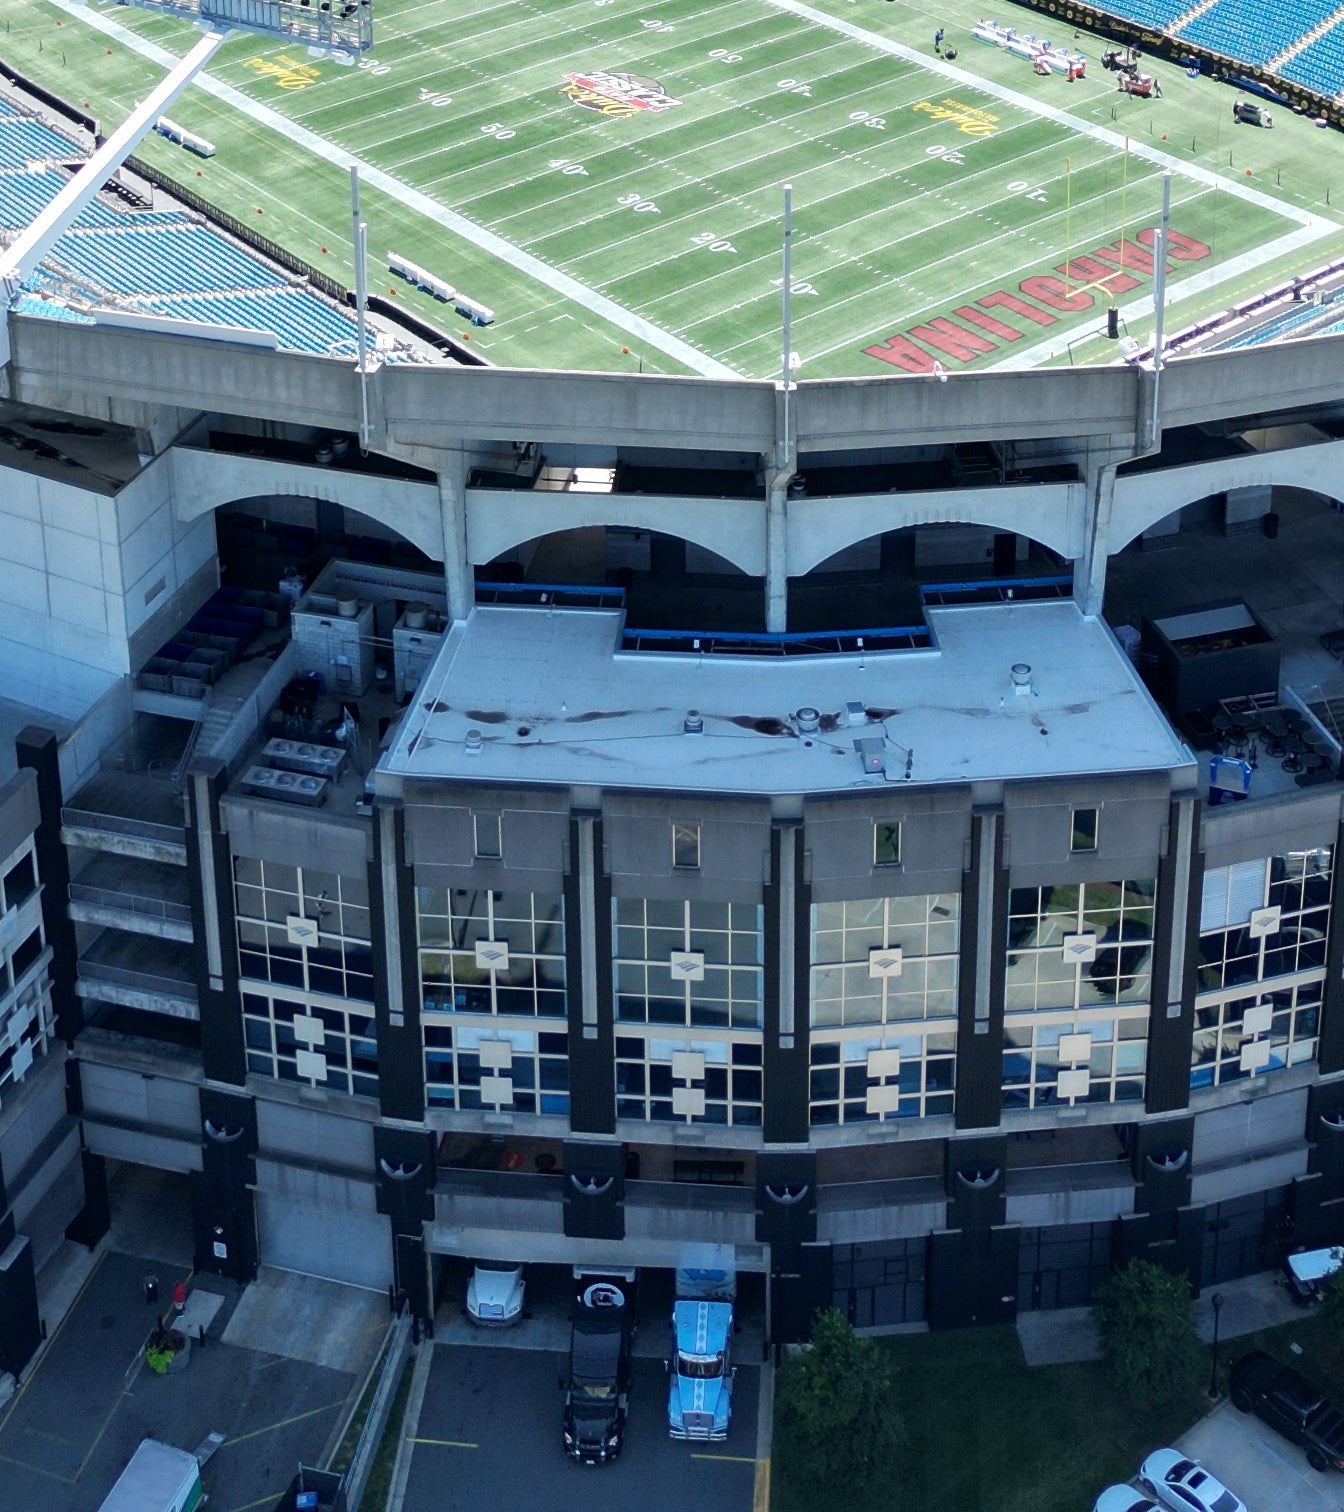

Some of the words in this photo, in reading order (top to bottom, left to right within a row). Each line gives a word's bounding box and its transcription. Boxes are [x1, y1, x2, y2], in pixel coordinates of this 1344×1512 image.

[643, 19, 677, 33] 40
[708, 48, 744, 64] 50
[357, 57, 392, 75] 30
[776, 79, 811, 96] 40
[419, 88, 452, 107] 40
[848, 111, 886, 129] 30
[480, 123, 517, 140] 50
[925, 145, 964, 164] 20
[547, 158, 584, 176] 40
[1006, 181, 1047, 202] 10
[616, 193, 655, 213] 30
[689, 232, 731, 252] 20
[860, 226, 1212, 374] CAROLINA
